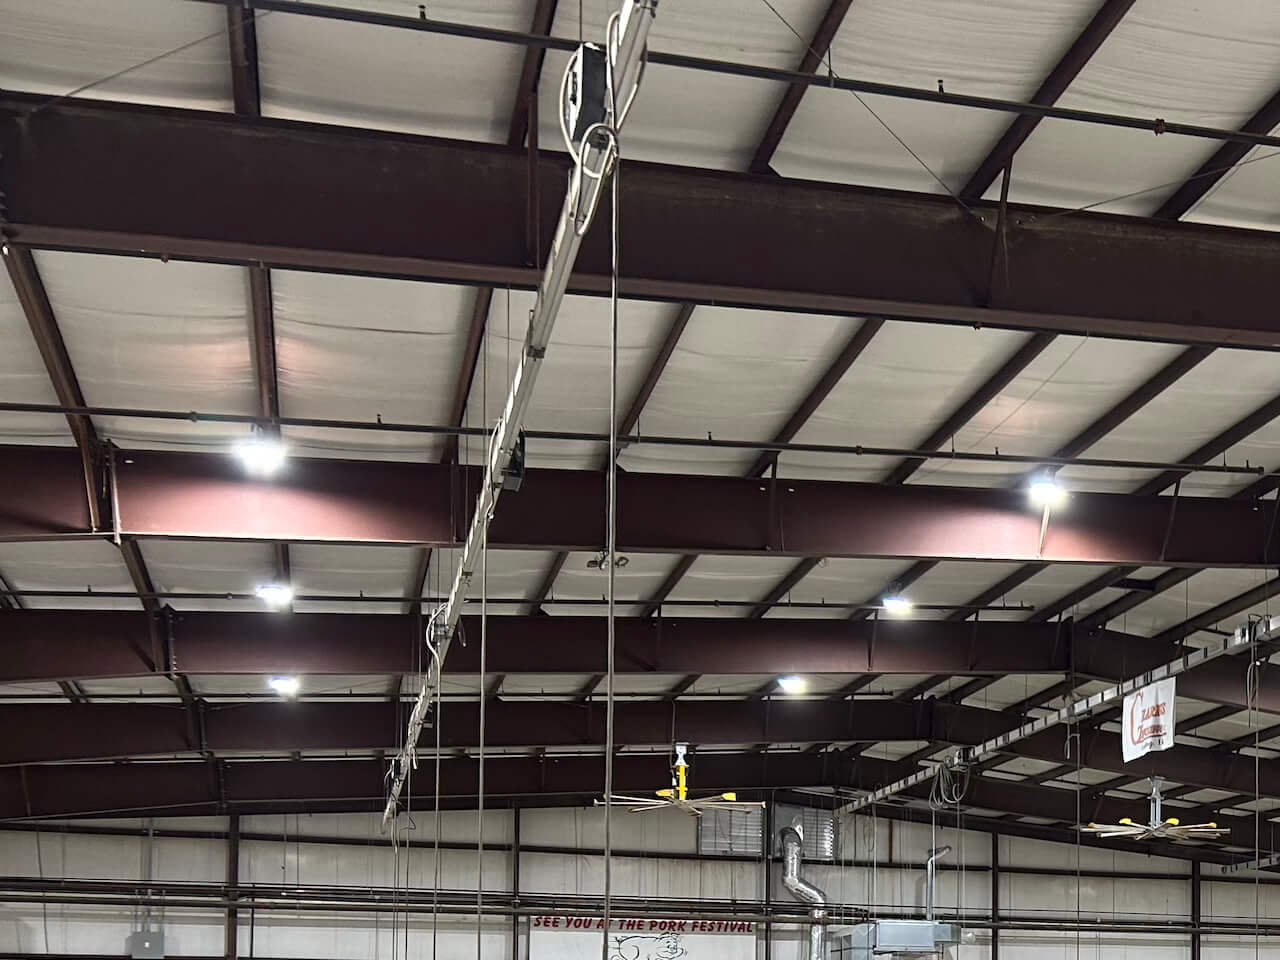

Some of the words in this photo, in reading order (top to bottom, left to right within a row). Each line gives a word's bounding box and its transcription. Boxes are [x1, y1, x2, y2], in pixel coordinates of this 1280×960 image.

[533, 916, 561, 928] SEE
[566, 917, 593, 929] YOU
[596, 918, 614, 930] AT
[618, 919, 645, 930] THE
[649, 920, 687, 932] PORK
[691, 921, 754, 933] FESTIVAL
